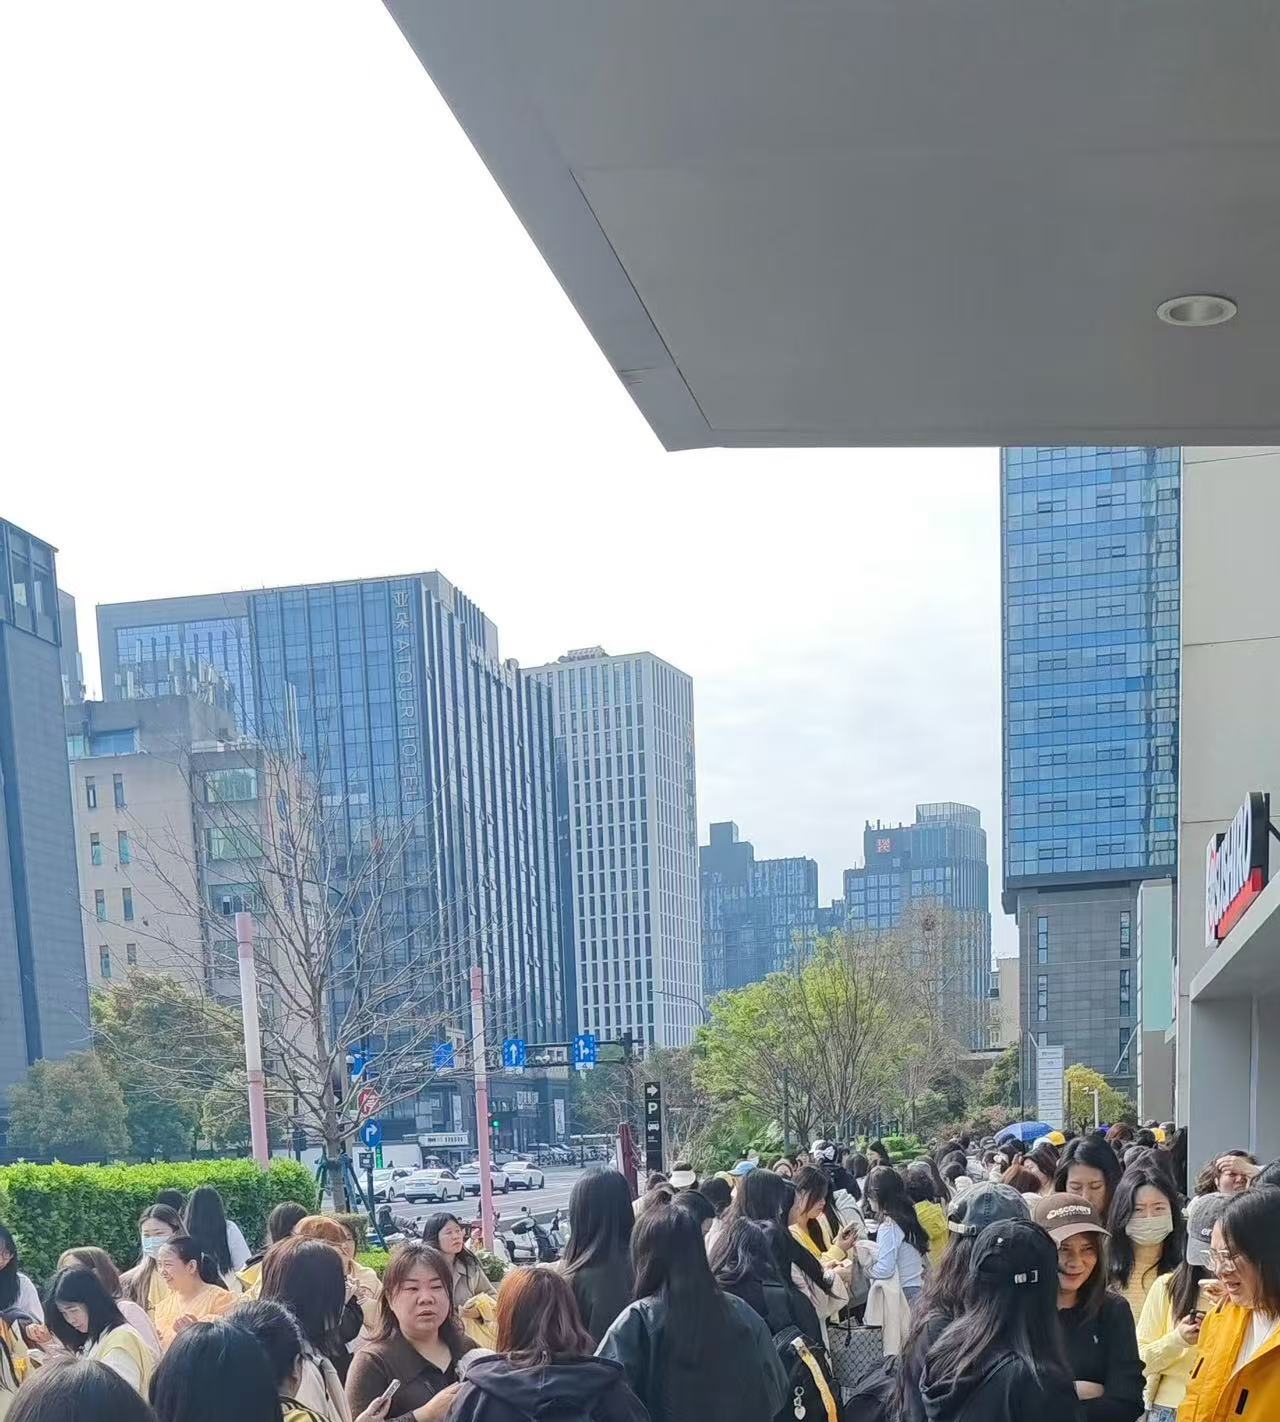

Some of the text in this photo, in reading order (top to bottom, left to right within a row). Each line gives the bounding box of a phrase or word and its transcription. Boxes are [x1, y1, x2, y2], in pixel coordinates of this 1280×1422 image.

[392, 591, 411, 630] 亚朵
[395, 638, 419, 802] ATOUR HOTEL
[647, 1102, 658, 1115] P
